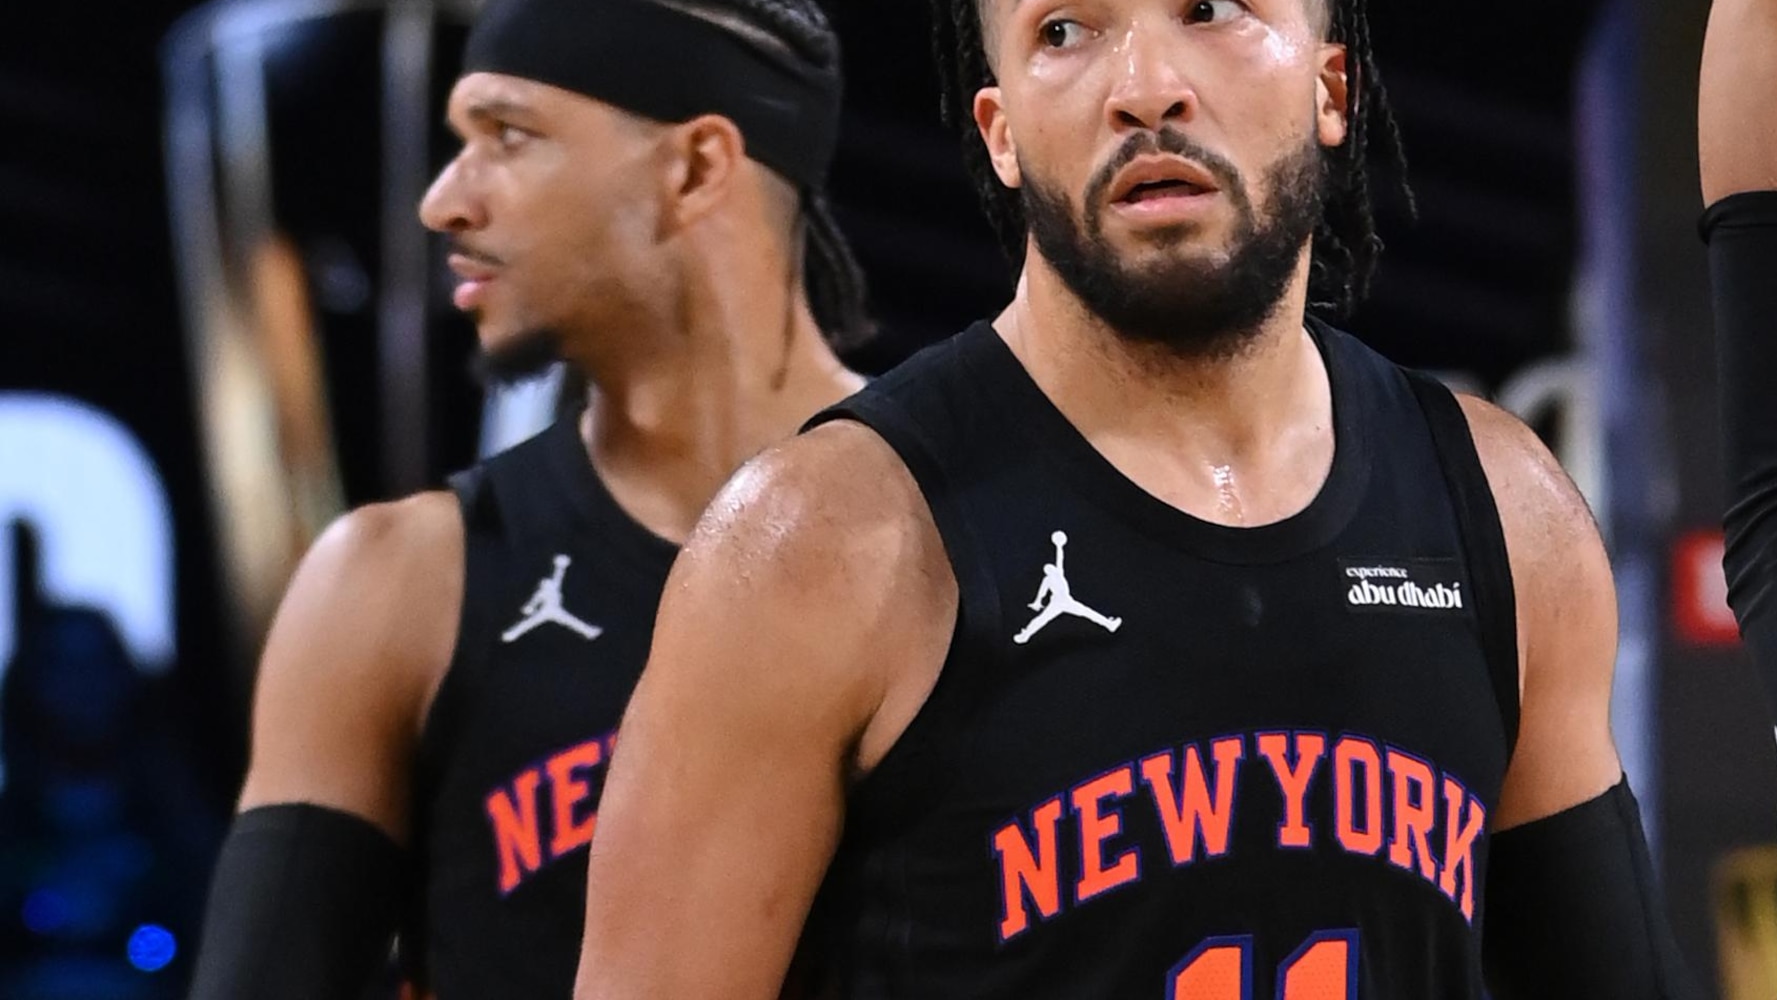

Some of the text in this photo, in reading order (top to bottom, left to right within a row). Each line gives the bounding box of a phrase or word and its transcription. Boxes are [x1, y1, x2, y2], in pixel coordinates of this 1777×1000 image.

[1347, 579, 1463, 609] abu dhabi
[486, 729, 618, 894] NE
[992, 726, 1487, 944] NEW YORK
